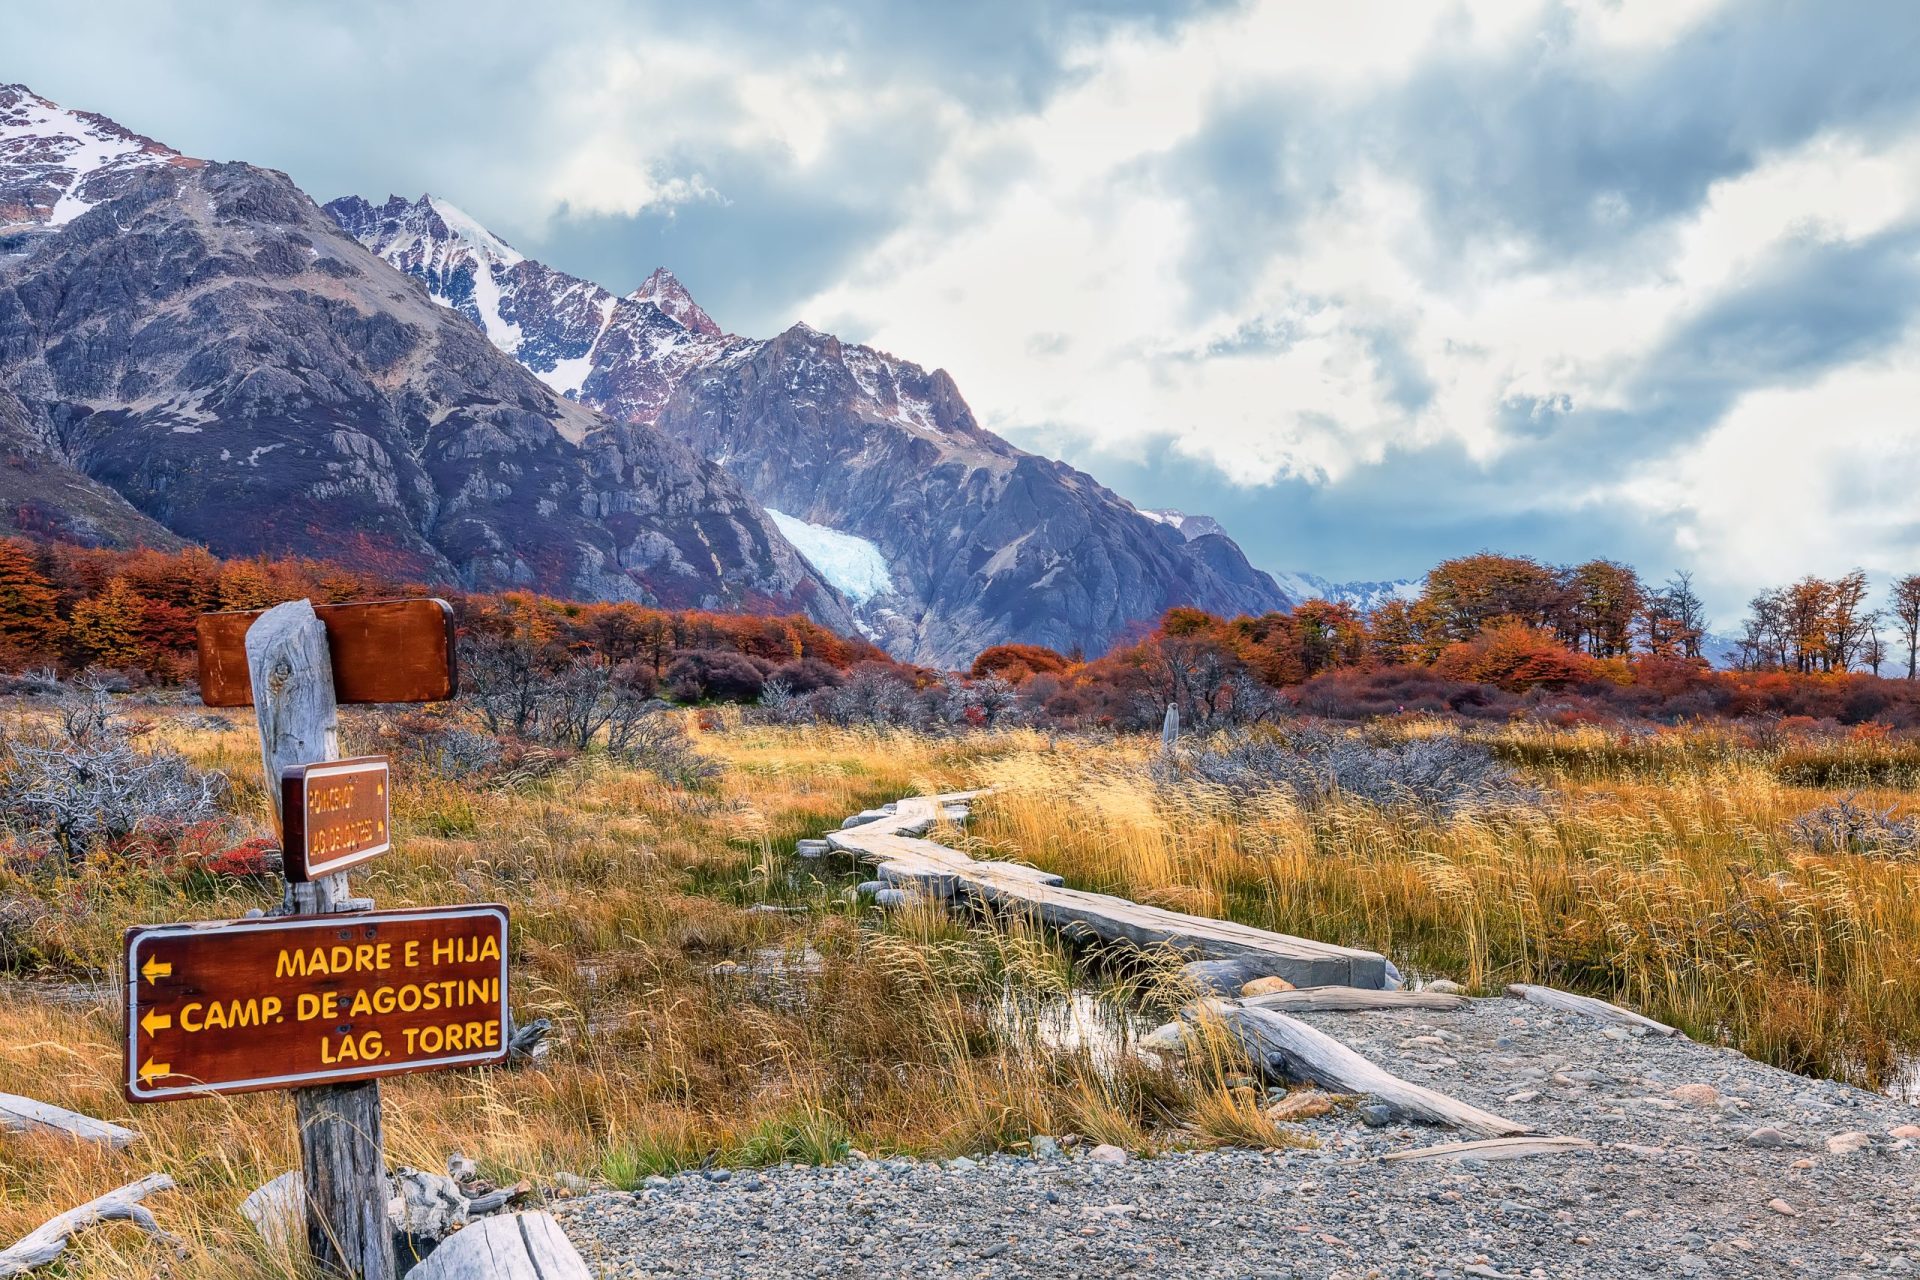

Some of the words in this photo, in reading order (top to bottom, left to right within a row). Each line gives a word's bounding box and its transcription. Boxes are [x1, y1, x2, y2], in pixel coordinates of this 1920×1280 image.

[330, 827, 340, 851] DE
[275, 942, 391, 978] MADRE
[404, 940, 420, 968] E
[432, 935, 500, 965] HIJA
[180, 995, 283, 1033] CAMP.
[297, 991, 338, 1022] DE
[349, 977, 499, 1017] AGOSTINI
[321, 1031, 391, 1064] LAG.
[402, 1020, 500, 1055] TORRE
